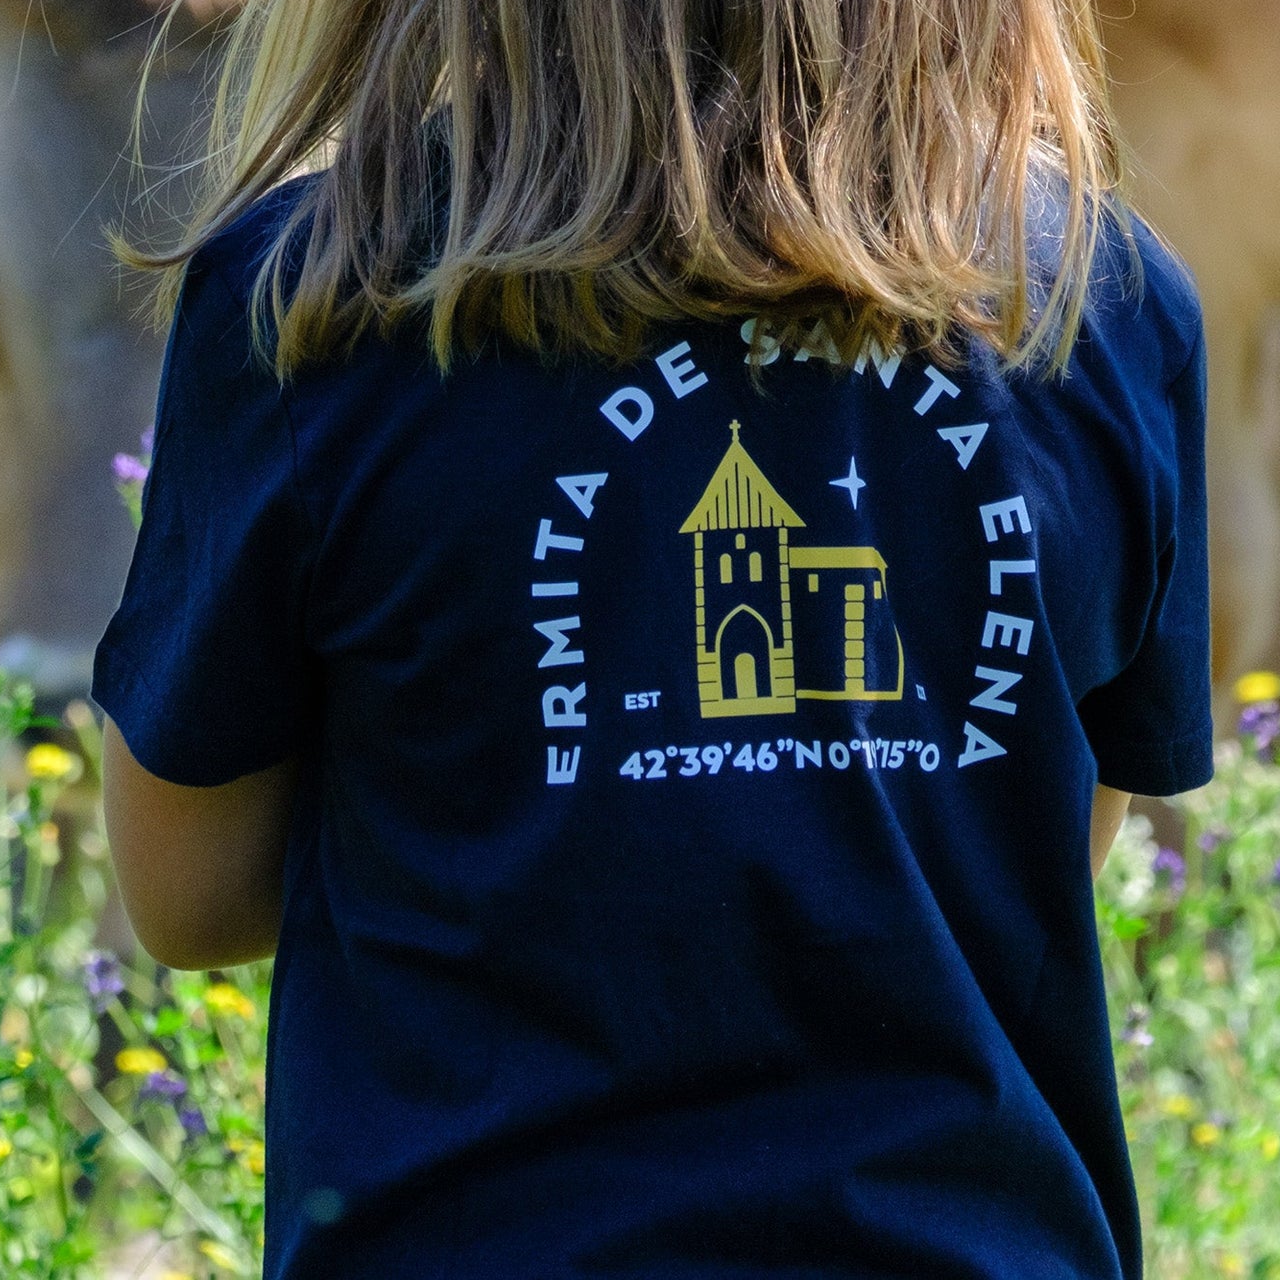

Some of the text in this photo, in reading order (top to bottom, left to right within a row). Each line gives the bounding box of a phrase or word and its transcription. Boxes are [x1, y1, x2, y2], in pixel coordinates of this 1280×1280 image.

[532, 472, 609, 784] ERMITA
[600, 341, 709, 441] DE
[957, 495, 1036, 768] ELENA
[624, 691, 661, 710] EST
